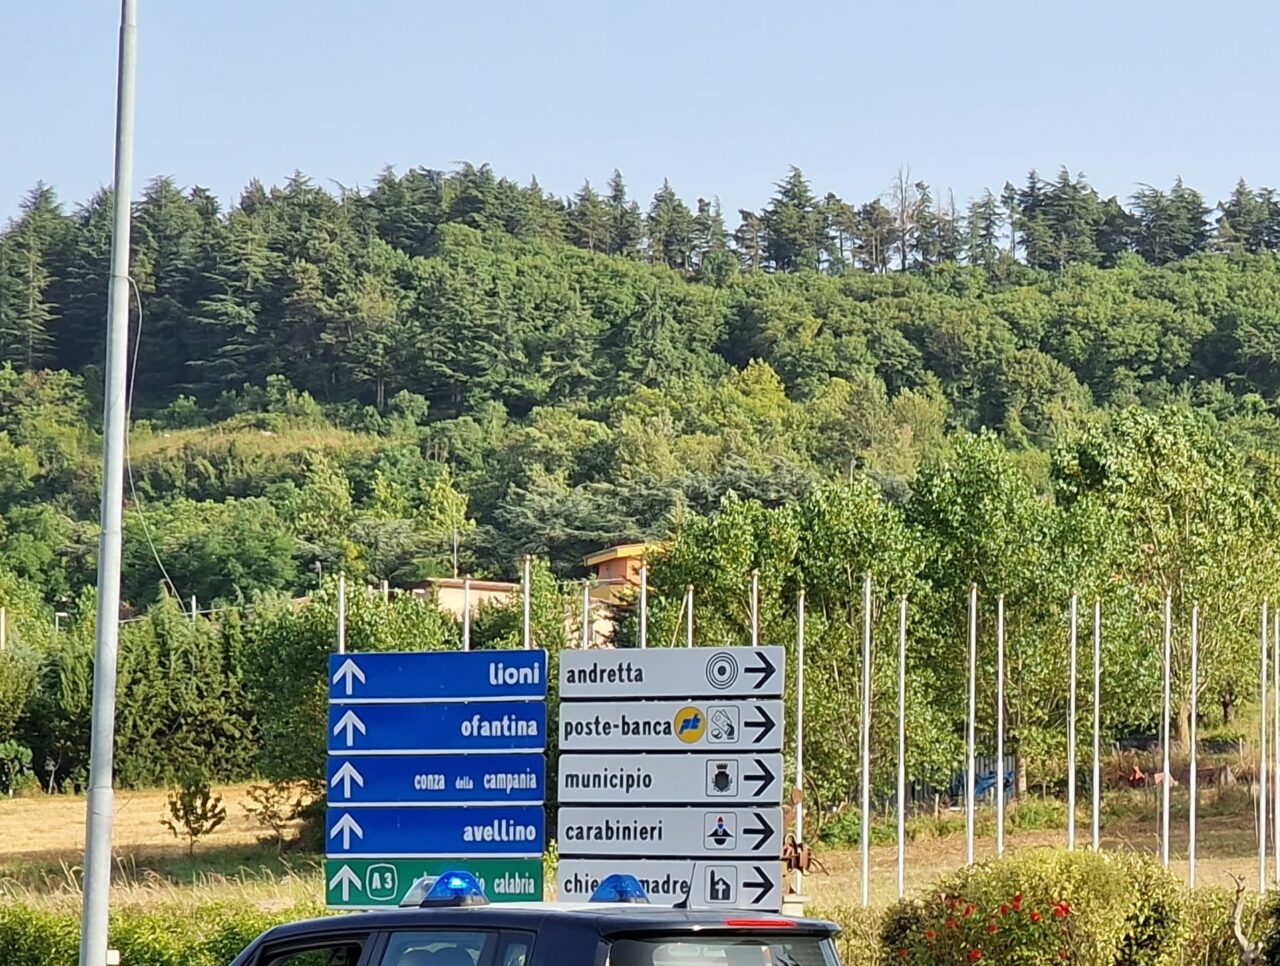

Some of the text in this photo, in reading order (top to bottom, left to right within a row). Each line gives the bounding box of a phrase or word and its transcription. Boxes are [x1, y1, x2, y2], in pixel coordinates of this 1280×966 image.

[489, 662, 540, 686] lioni
[566, 662, 644, 684] andretta
[461, 714, 538, 737] ofantina
[564, 715, 672, 741] poste-banca
[414, 774, 446, 790] conza
[483, 768, 537, 794] campania
[564, 768, 652, 793] municipio
[463, 820, 536, 842] avellino
[565, 820, 663, 841] carabinieri
[493, 871, 535, 894] calabria
